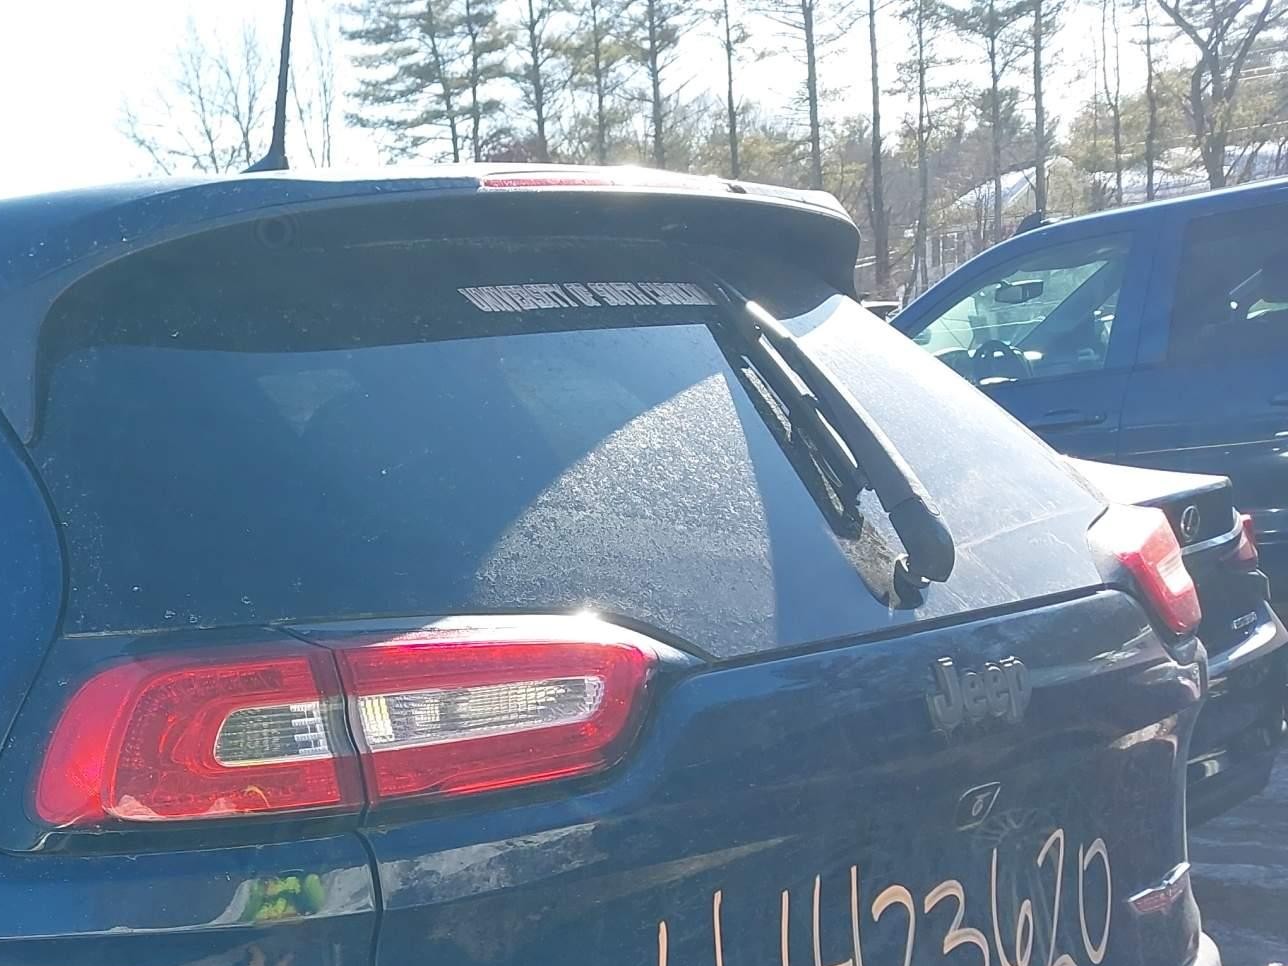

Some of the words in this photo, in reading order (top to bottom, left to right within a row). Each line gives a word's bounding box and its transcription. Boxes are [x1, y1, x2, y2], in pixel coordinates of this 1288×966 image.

[457, 285, 569, 313] UNIVERSITY
[563, 283, 602, 307] OF
[586, 282, 656, 307] SOUTH
[926, 655, 1032, 730] Jeep
